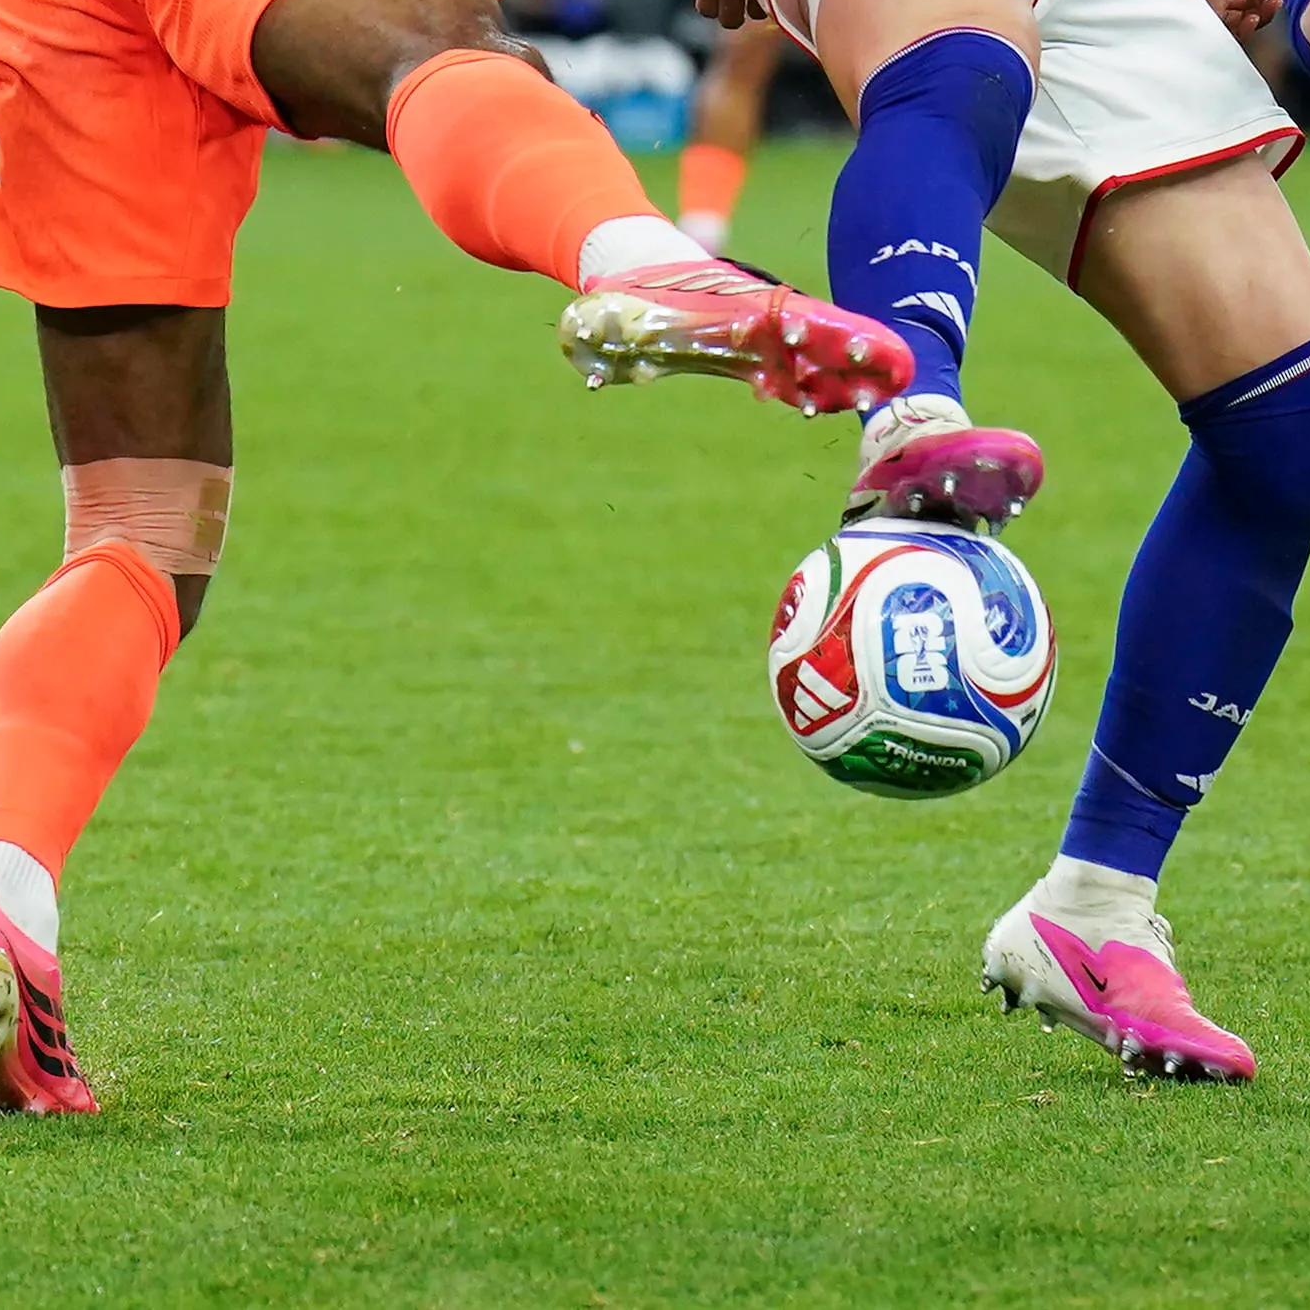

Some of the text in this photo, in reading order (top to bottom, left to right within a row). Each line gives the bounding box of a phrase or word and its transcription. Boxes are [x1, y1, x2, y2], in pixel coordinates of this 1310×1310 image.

[868, 238, 978, 298] JAPA
[912, 674, 935, 685] FIFA
[883, 739, 968, 768] TRIONDA
